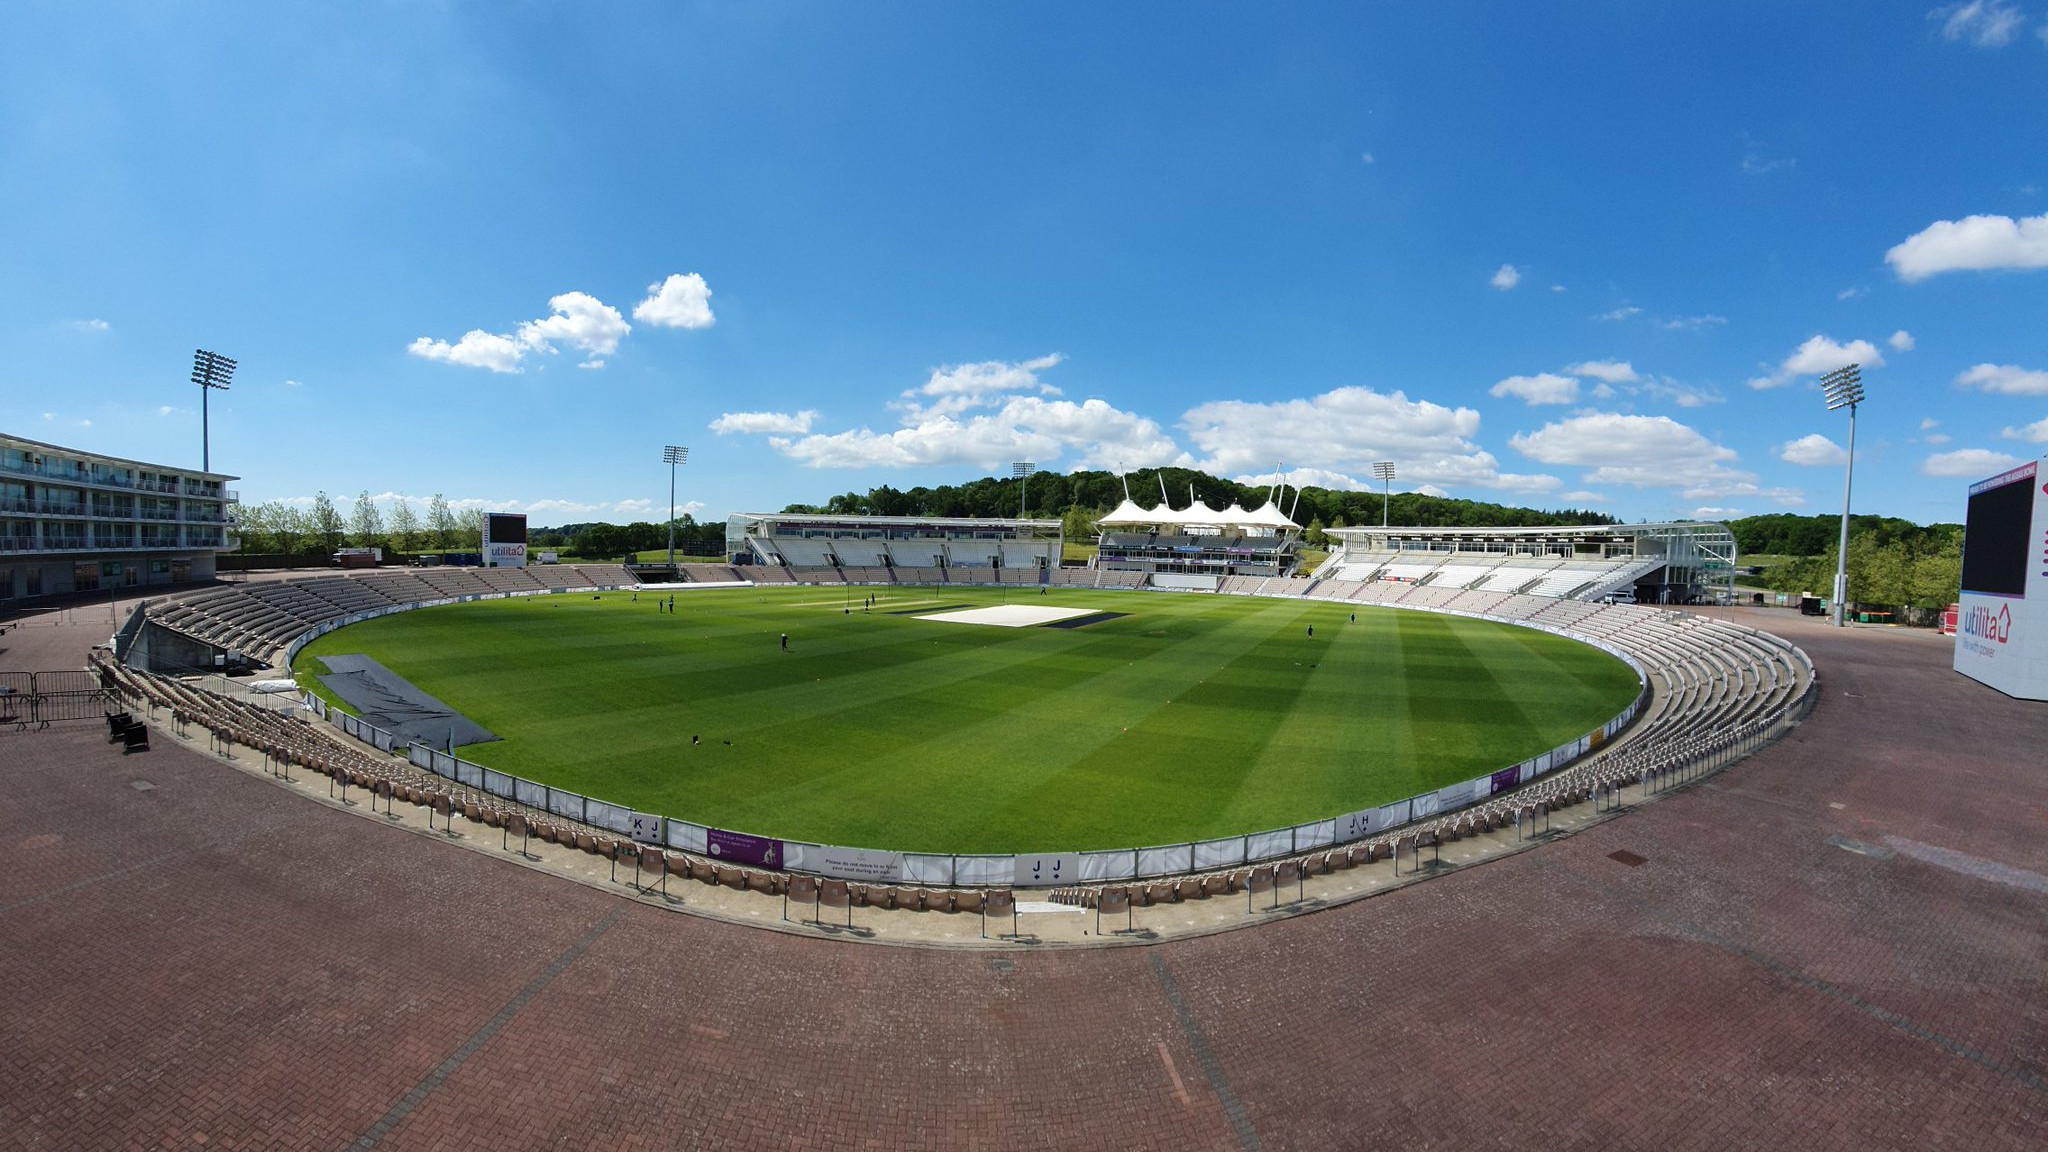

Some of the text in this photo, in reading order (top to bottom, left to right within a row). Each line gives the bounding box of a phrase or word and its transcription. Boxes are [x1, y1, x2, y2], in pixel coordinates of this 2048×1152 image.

[492, 546, 516, 556] utilita
[1965, 606, 1997, 640] utilita
[634, 819, 658, 831] K J
[1350, 815, 1368, 828] J H
[1033, 860, 1060, 872] J J
